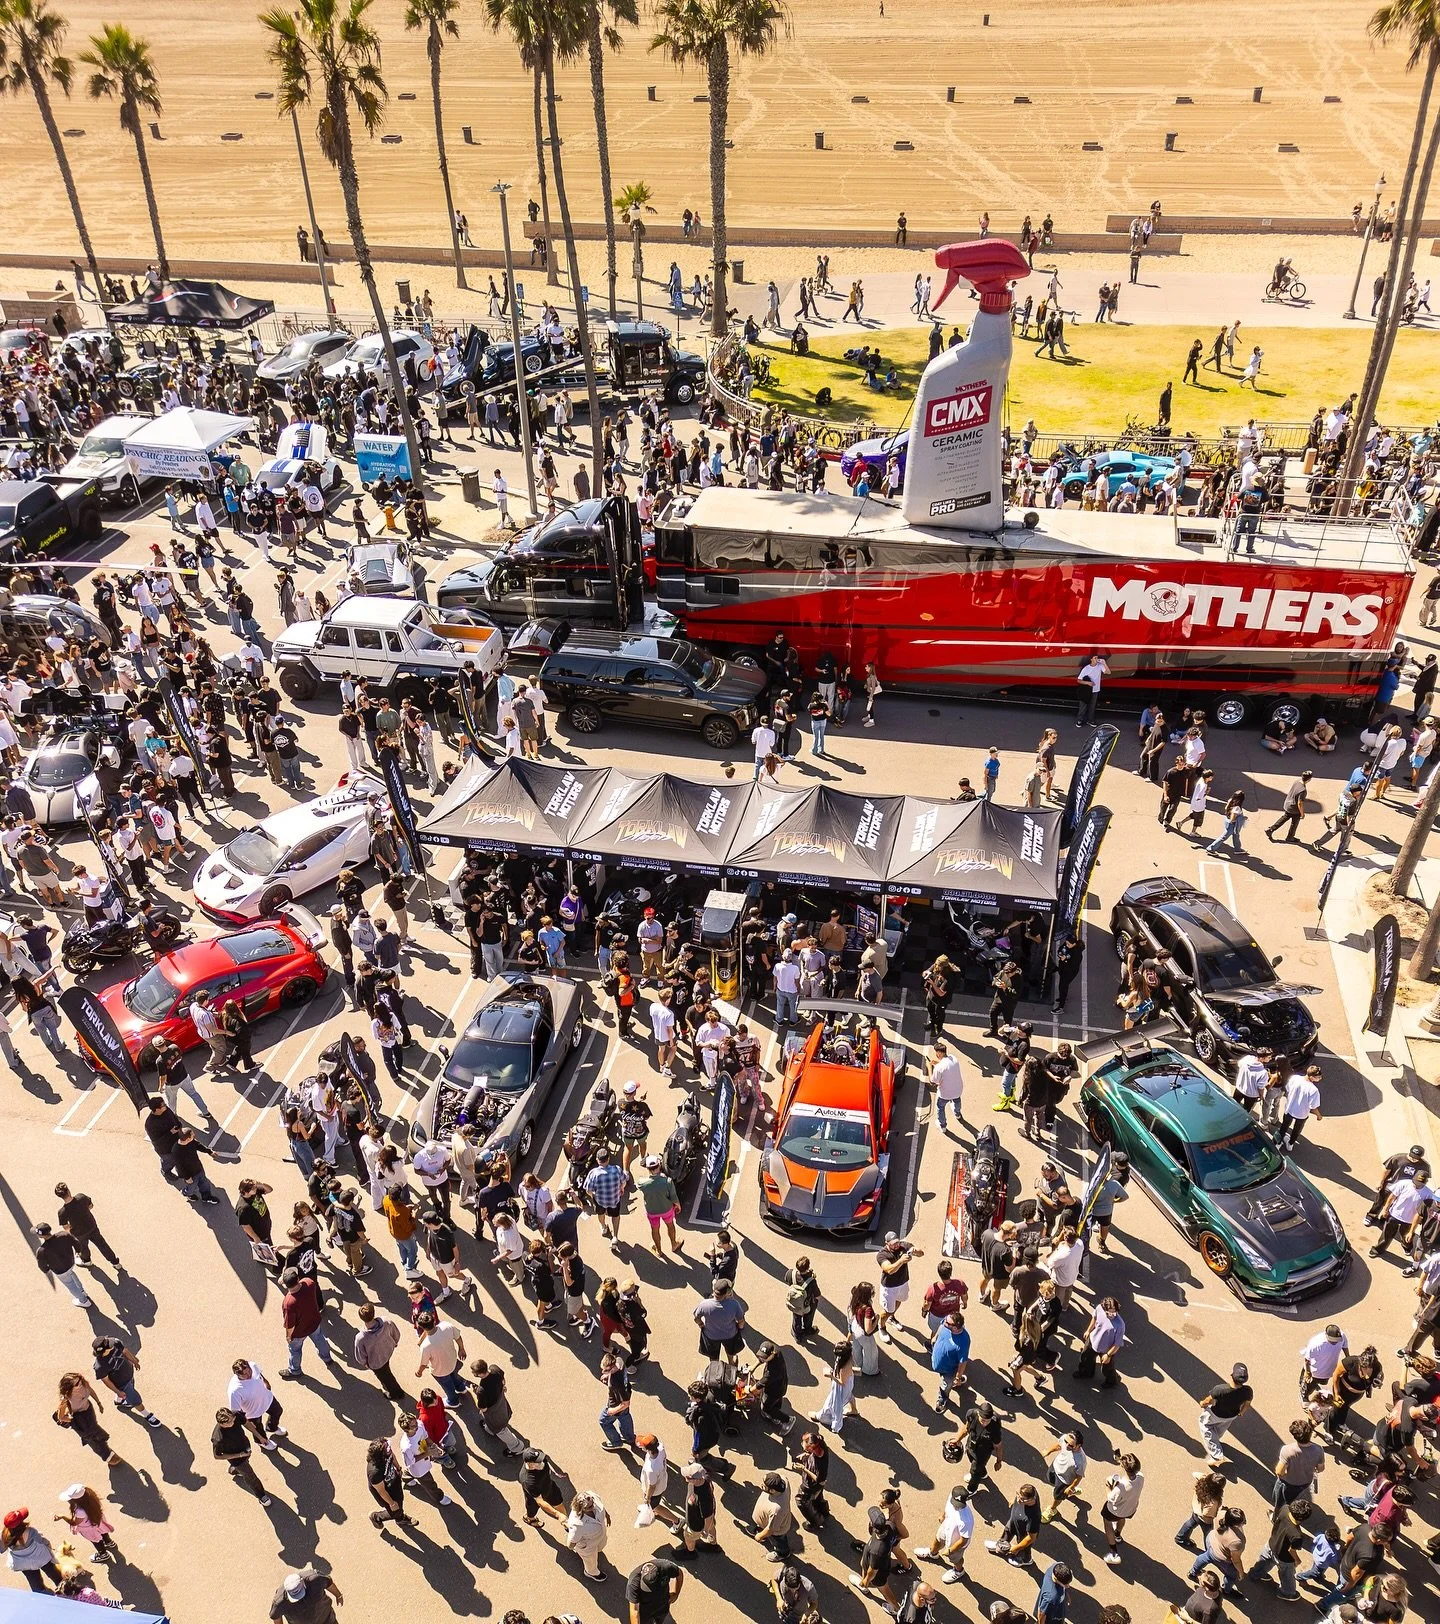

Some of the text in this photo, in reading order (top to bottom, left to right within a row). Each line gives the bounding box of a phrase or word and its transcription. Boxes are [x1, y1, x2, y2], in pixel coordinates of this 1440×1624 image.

[955, 380, 987, 393] MOTHERS
[931, 392, 987, 427] CMX
[126, 448, 162, 460] PSYCHIC
[164, 454, 207, 462] READINGS
[363, 441, 394, 452] WATER
[932, 429, 983, 448] CERAMIC
[940, 439, 983, 453] SPRAY COATING
[930, 503, 956, 516] PRO
[1081, 736, 1102, 788] MOTORS
[543, 771, 576, 816] TORKLAW
[556, 780, 584, 820] MOTORS
[462, 802, 537, 832] TORKLAW
[696, 788, 722, 834] TORKLAW
[708, 797, 731, 836] MOTORS
[853, 800, 875, 848] TORKLAW
[614, 820, 688, 849] TORKLAW
[864, 809, 884, 851] MOTORS
[1020, 814, 1034, 862] TORKLAW
[1031, 824, 1044, 866] MOTORS
[1074, 818, 1096, 869] MOTORS
[770, 832, 846, 864] TORKLAW
[933, 848, 1014, 881] TORKLAW
[646, 864, 672, 872] MOTORS
[777, 878, 804, 886] TORKLAW
[804, 880, 830, 888] MOTORS
[81, 997, 120, 1050] TORKLAW
